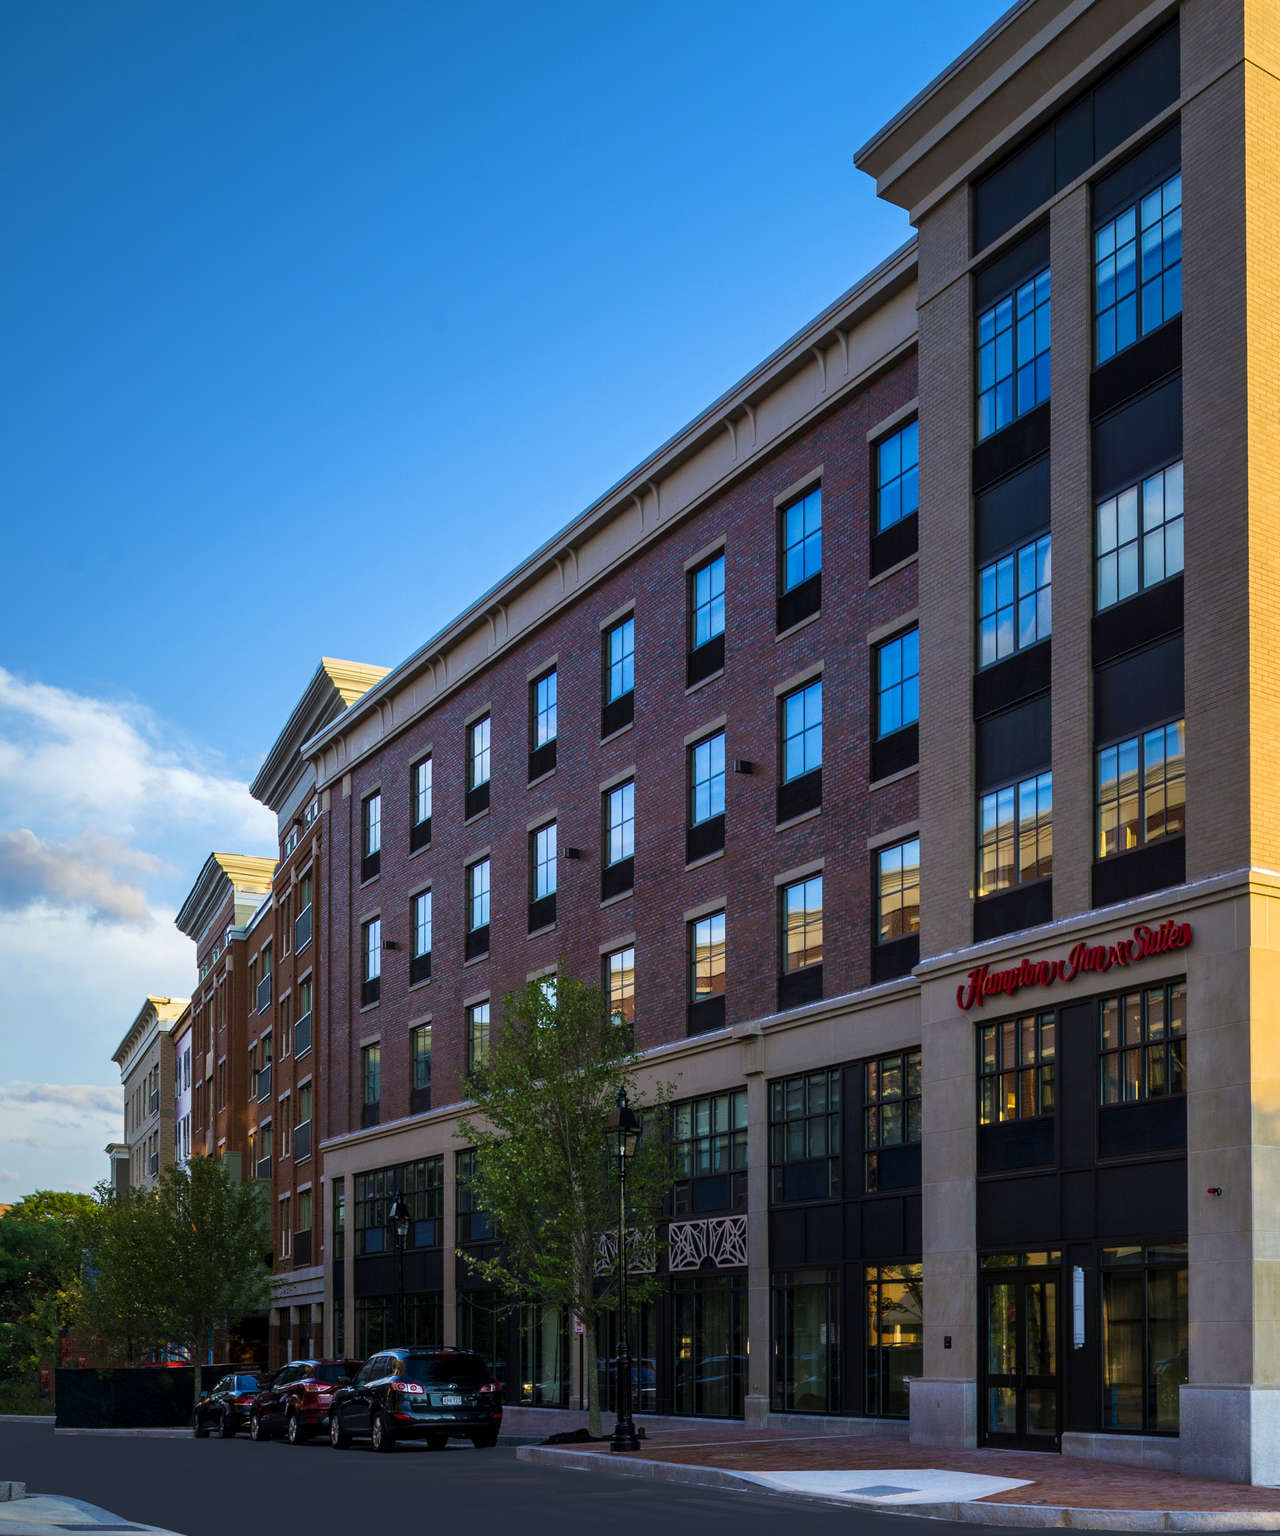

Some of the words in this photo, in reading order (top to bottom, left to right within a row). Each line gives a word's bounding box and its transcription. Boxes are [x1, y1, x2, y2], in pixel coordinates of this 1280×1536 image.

[956, 958, 1057, 1010] Hampton
[1057, 942, 1113, 982] Inn
[1111, 941, 1128, 966] &
[1125, 920, 1193, 961] Suites
